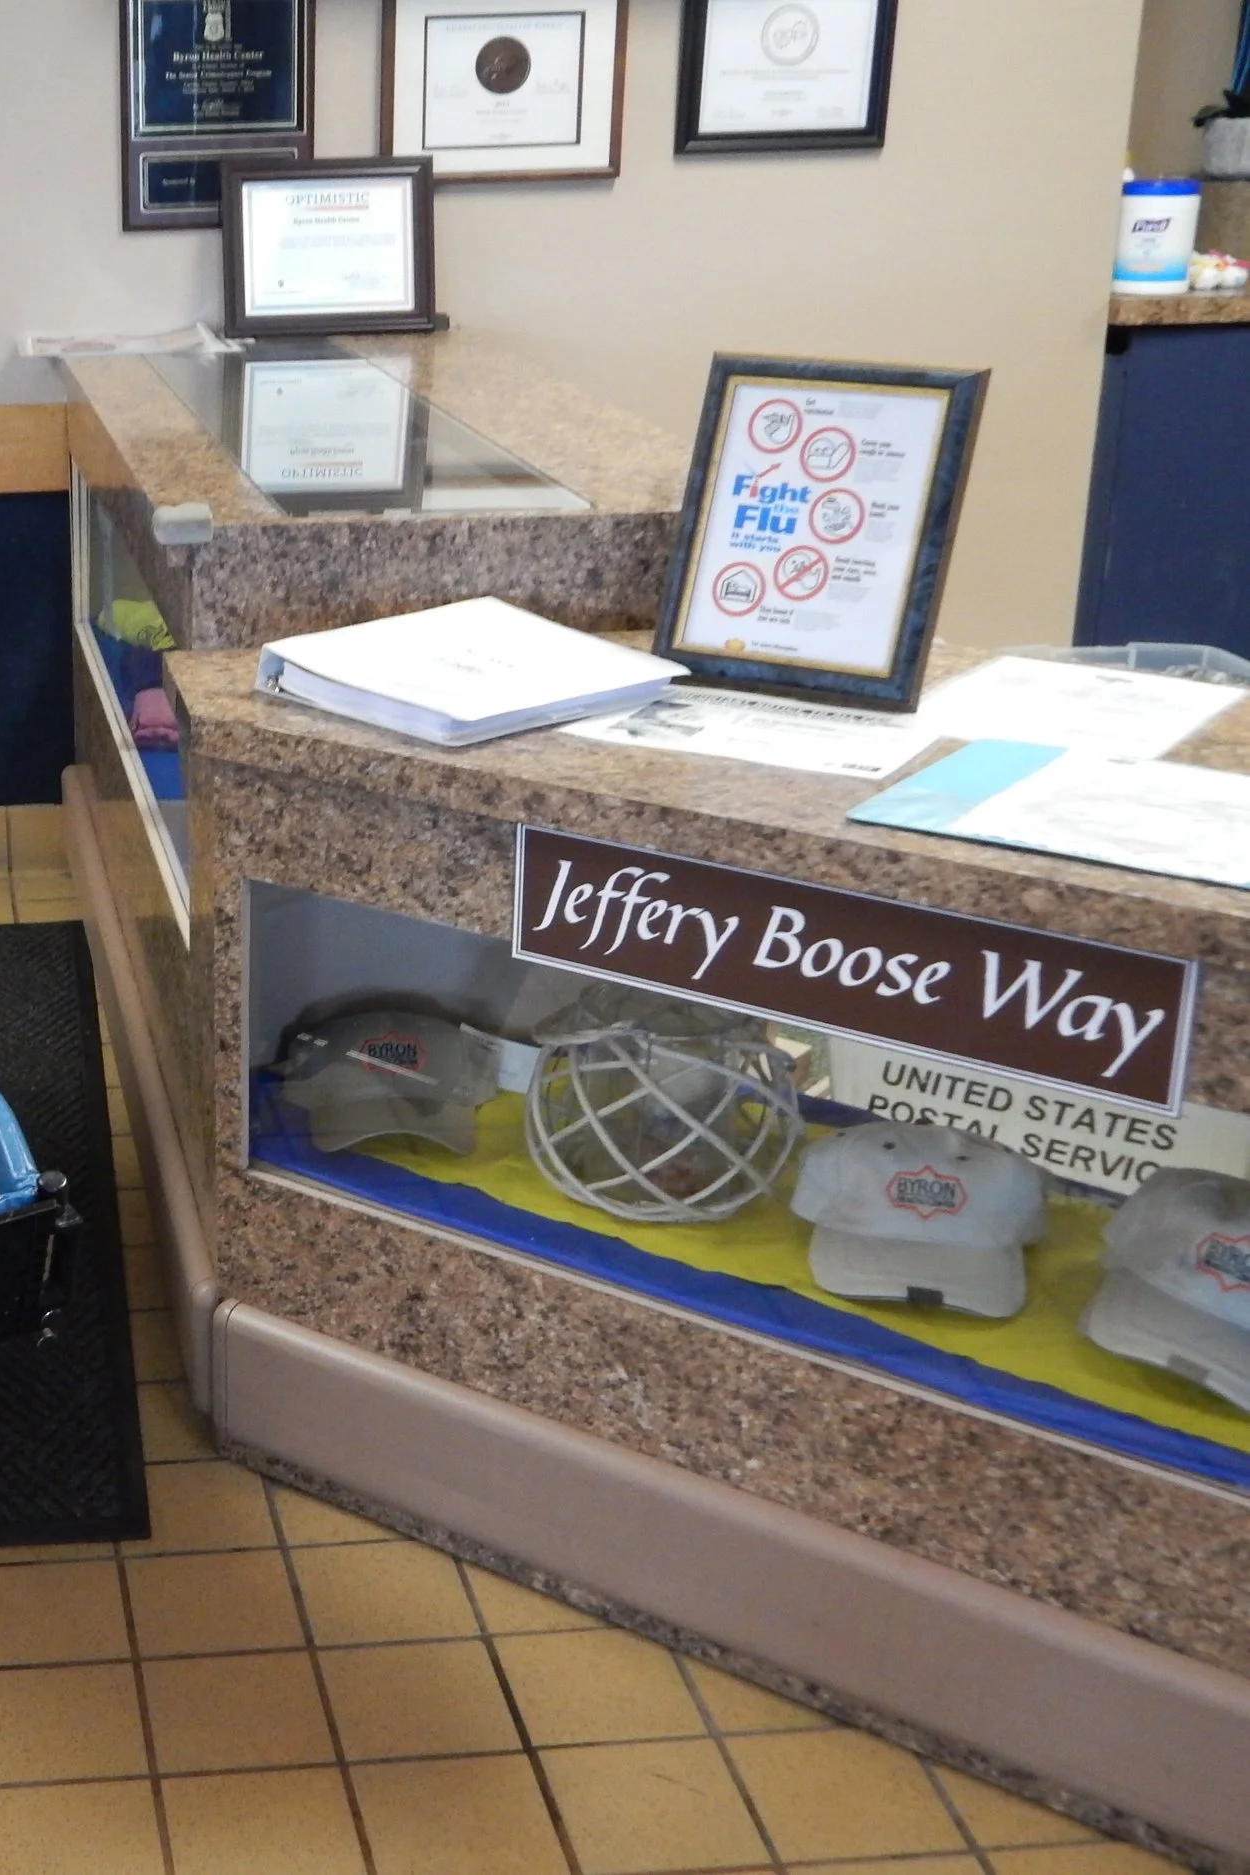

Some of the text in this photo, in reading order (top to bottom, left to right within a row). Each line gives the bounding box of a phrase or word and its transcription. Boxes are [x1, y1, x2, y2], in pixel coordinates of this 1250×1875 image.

[284, 191, 370, 206] OPTIMISTIC
[732, 473, 811, 504] Fight
[733, 504, 798, 534] Flu
[532, 859, 1164, 1078] Jeffery Boose Way
[368, 1041, 418, 1060] BYRON
[881, 1060, 1178, 1151] UNITED STATES
[1020, 1132, 1161, 1183] SERVIC
[896, 1177, 957, 1200] BYRON
